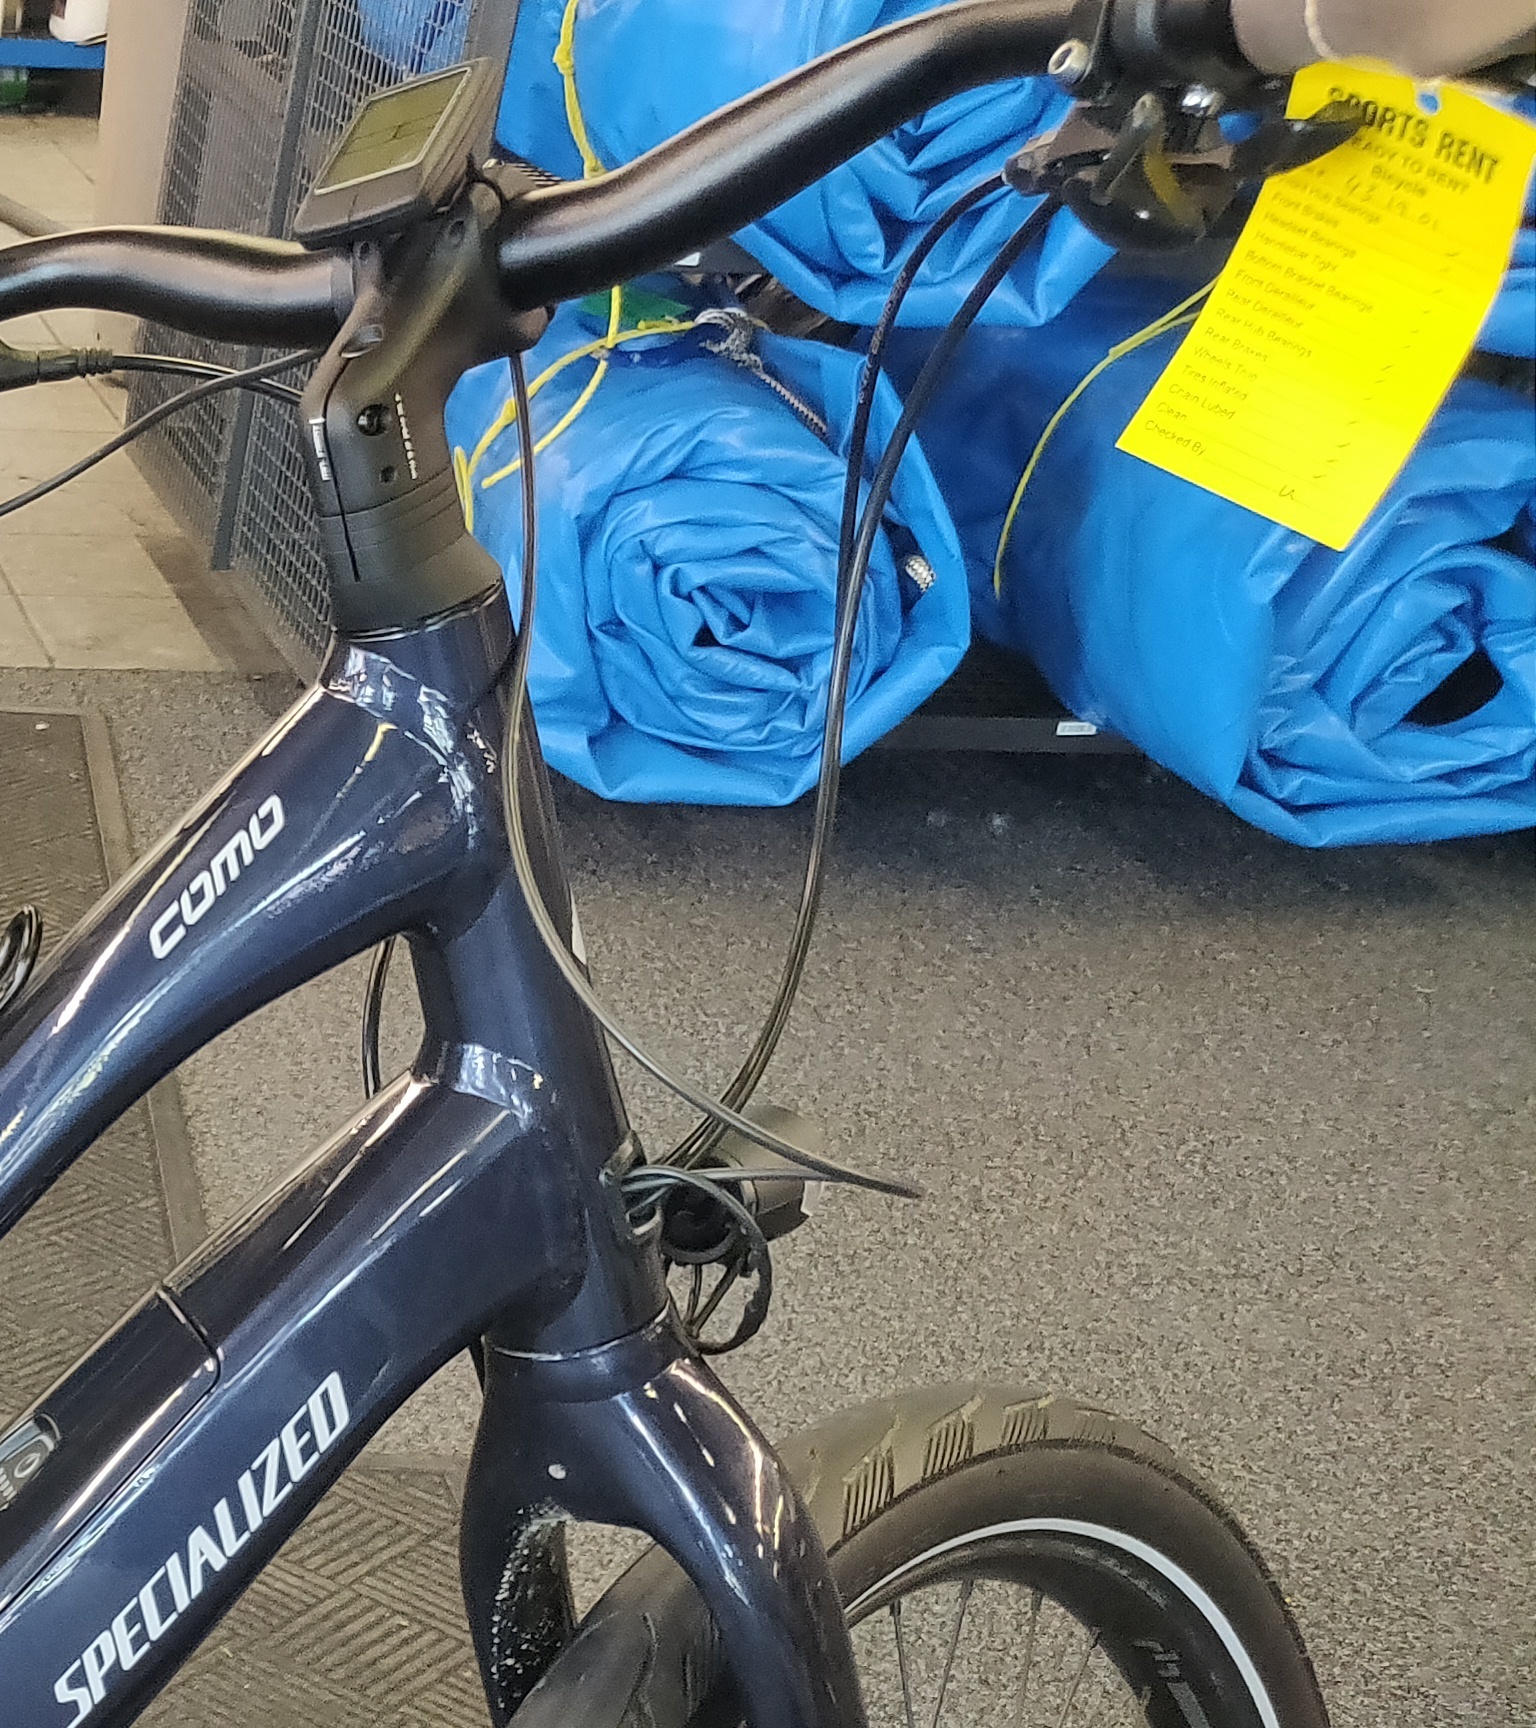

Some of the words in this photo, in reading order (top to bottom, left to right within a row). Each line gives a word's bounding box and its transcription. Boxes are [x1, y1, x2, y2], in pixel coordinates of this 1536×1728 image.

[1433, 130, 1500, 184] RENT
[1155, 400, 1189, 423] Clean
[1143, 418, 1192, 448] Checked
[1190, 440, 1207, 457] By
